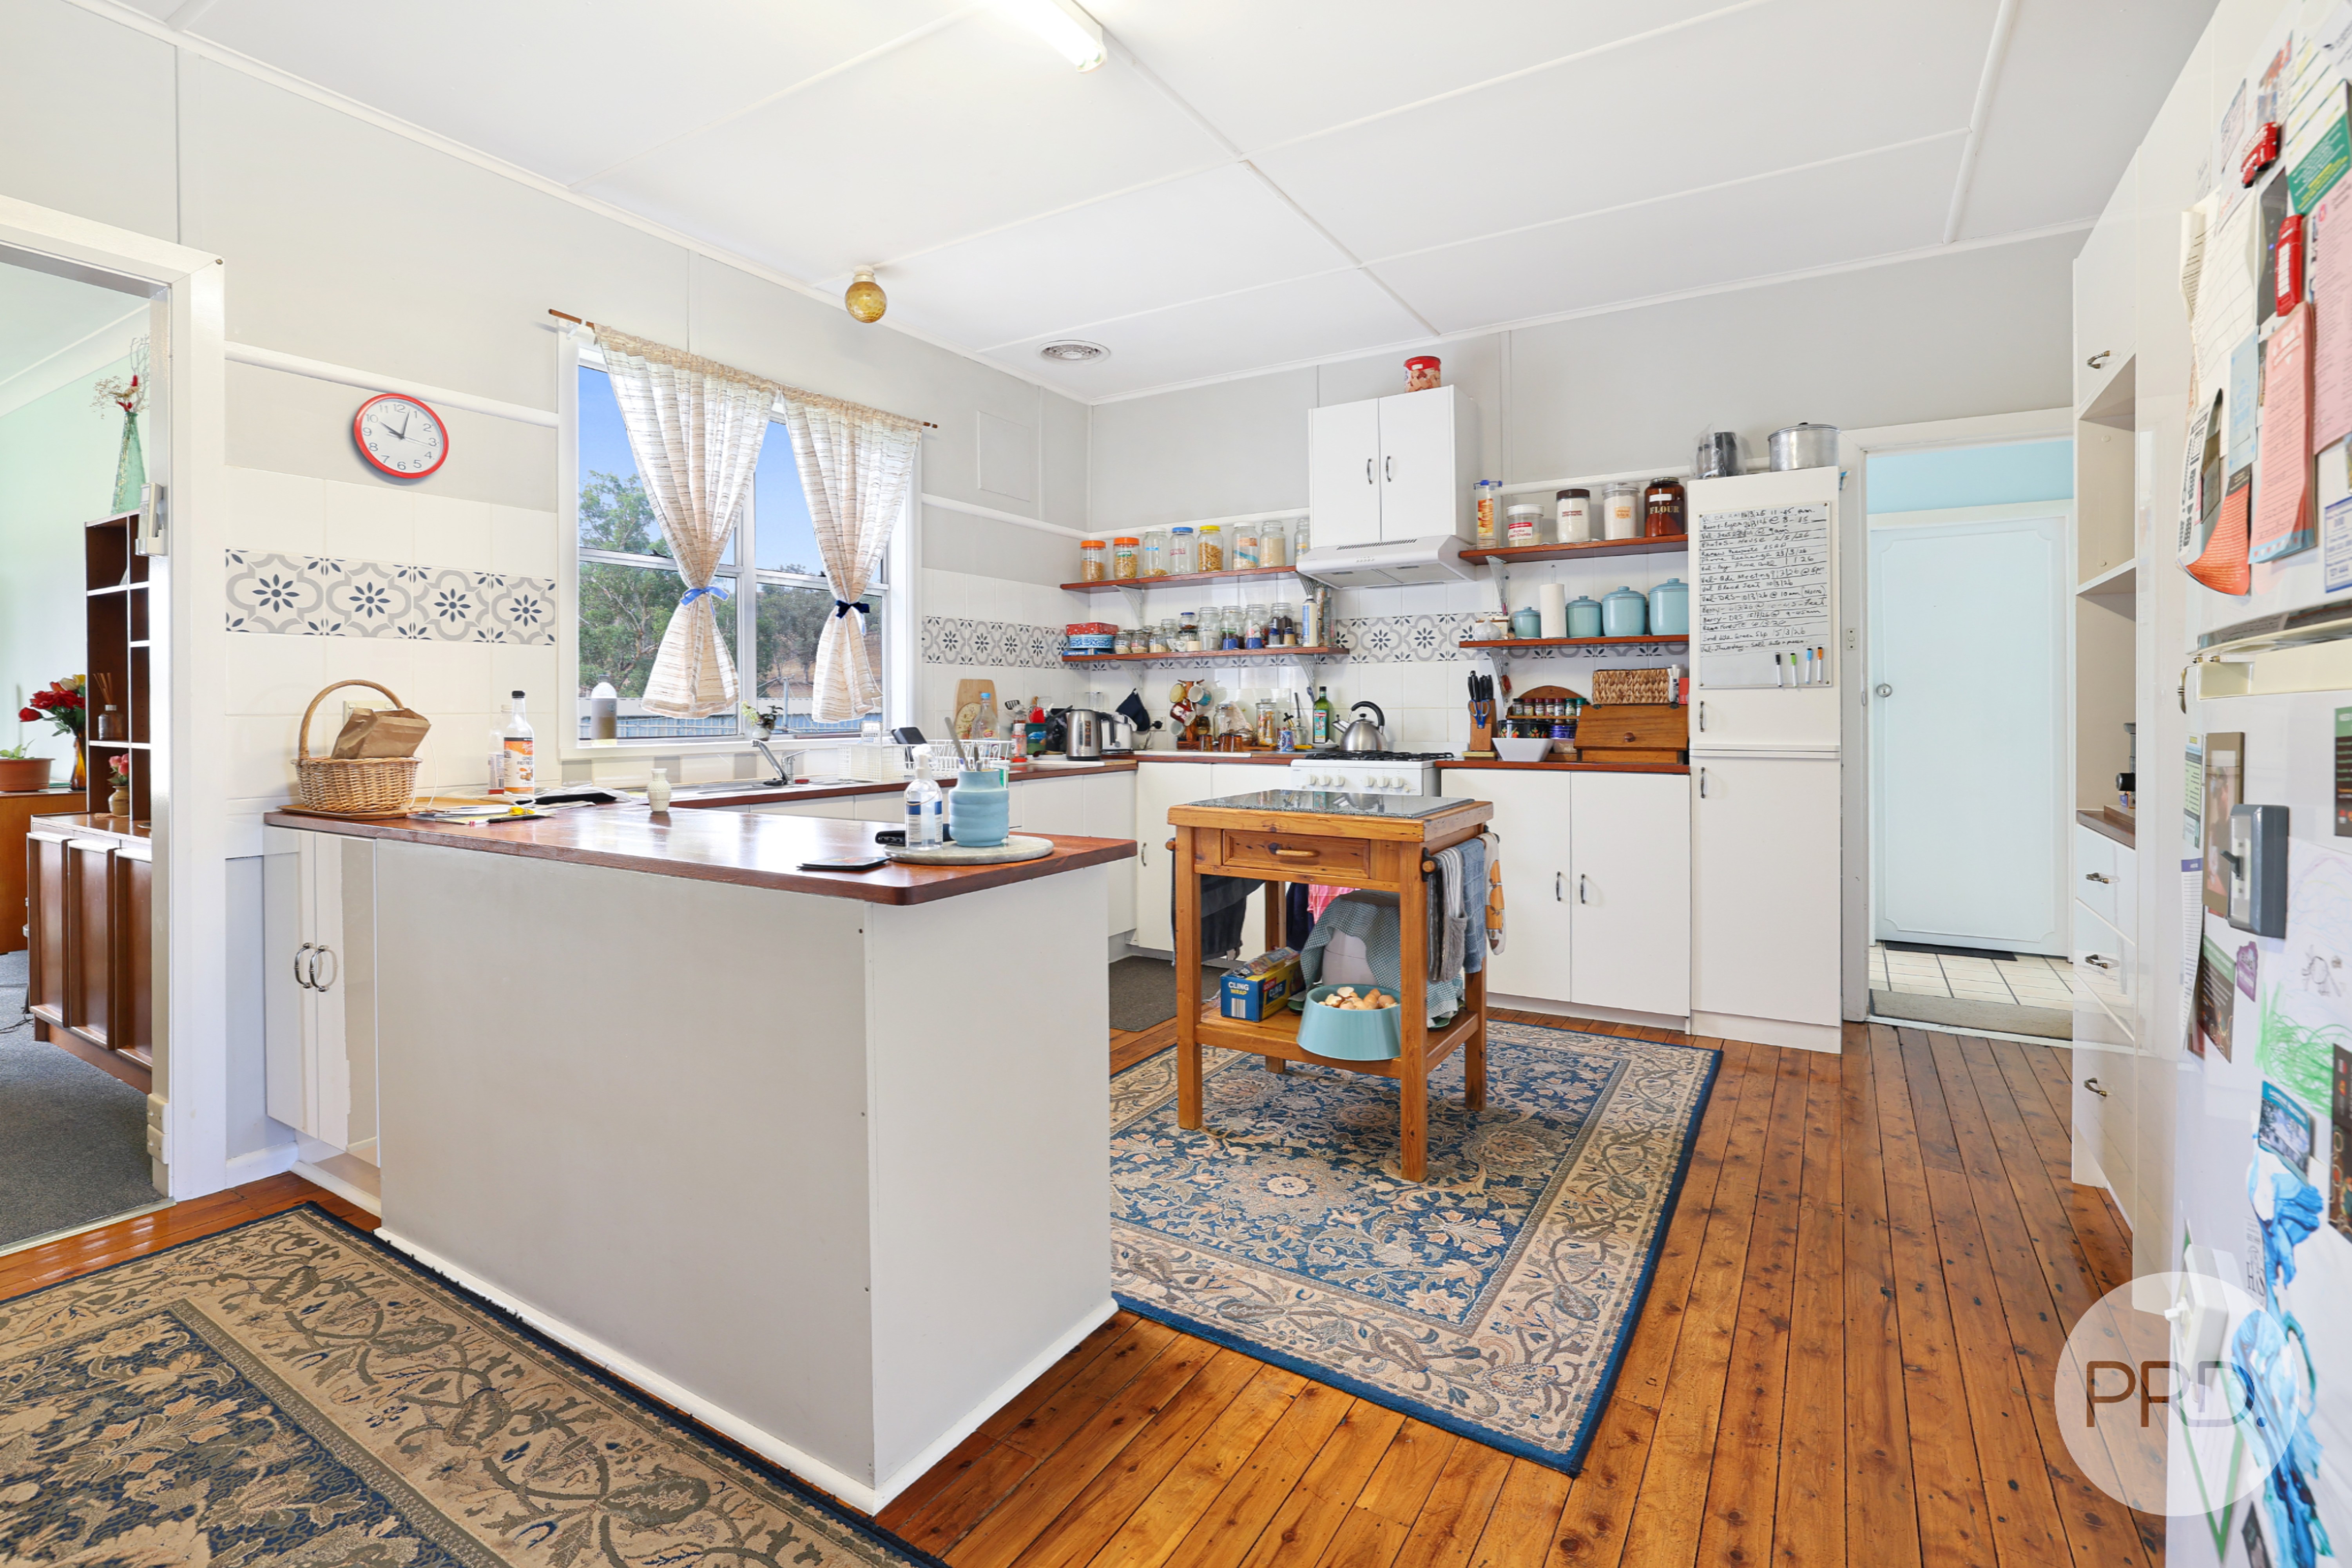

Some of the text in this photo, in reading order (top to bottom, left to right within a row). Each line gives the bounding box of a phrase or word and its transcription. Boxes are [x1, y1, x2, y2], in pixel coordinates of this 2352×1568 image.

[379, 404, 388, 413] 11
[393, 403, 406, 413] 12
[366, 413, 379, 424] 10
[362, 427, 372, 436] 9
[423, 423, 432, 432] 2
[369, 442, 379, 451] 8
[428, 437, 437, 447] 3
[381, 454, 390, 464] 7
[424, 451, 432, 459] 4
[397, 461, 406, 471] 6
[413, 459, 422, 469] 5
[1649, 505, 1680, 514] FLOUR
[1228, 981, 1249, 991] CLING
